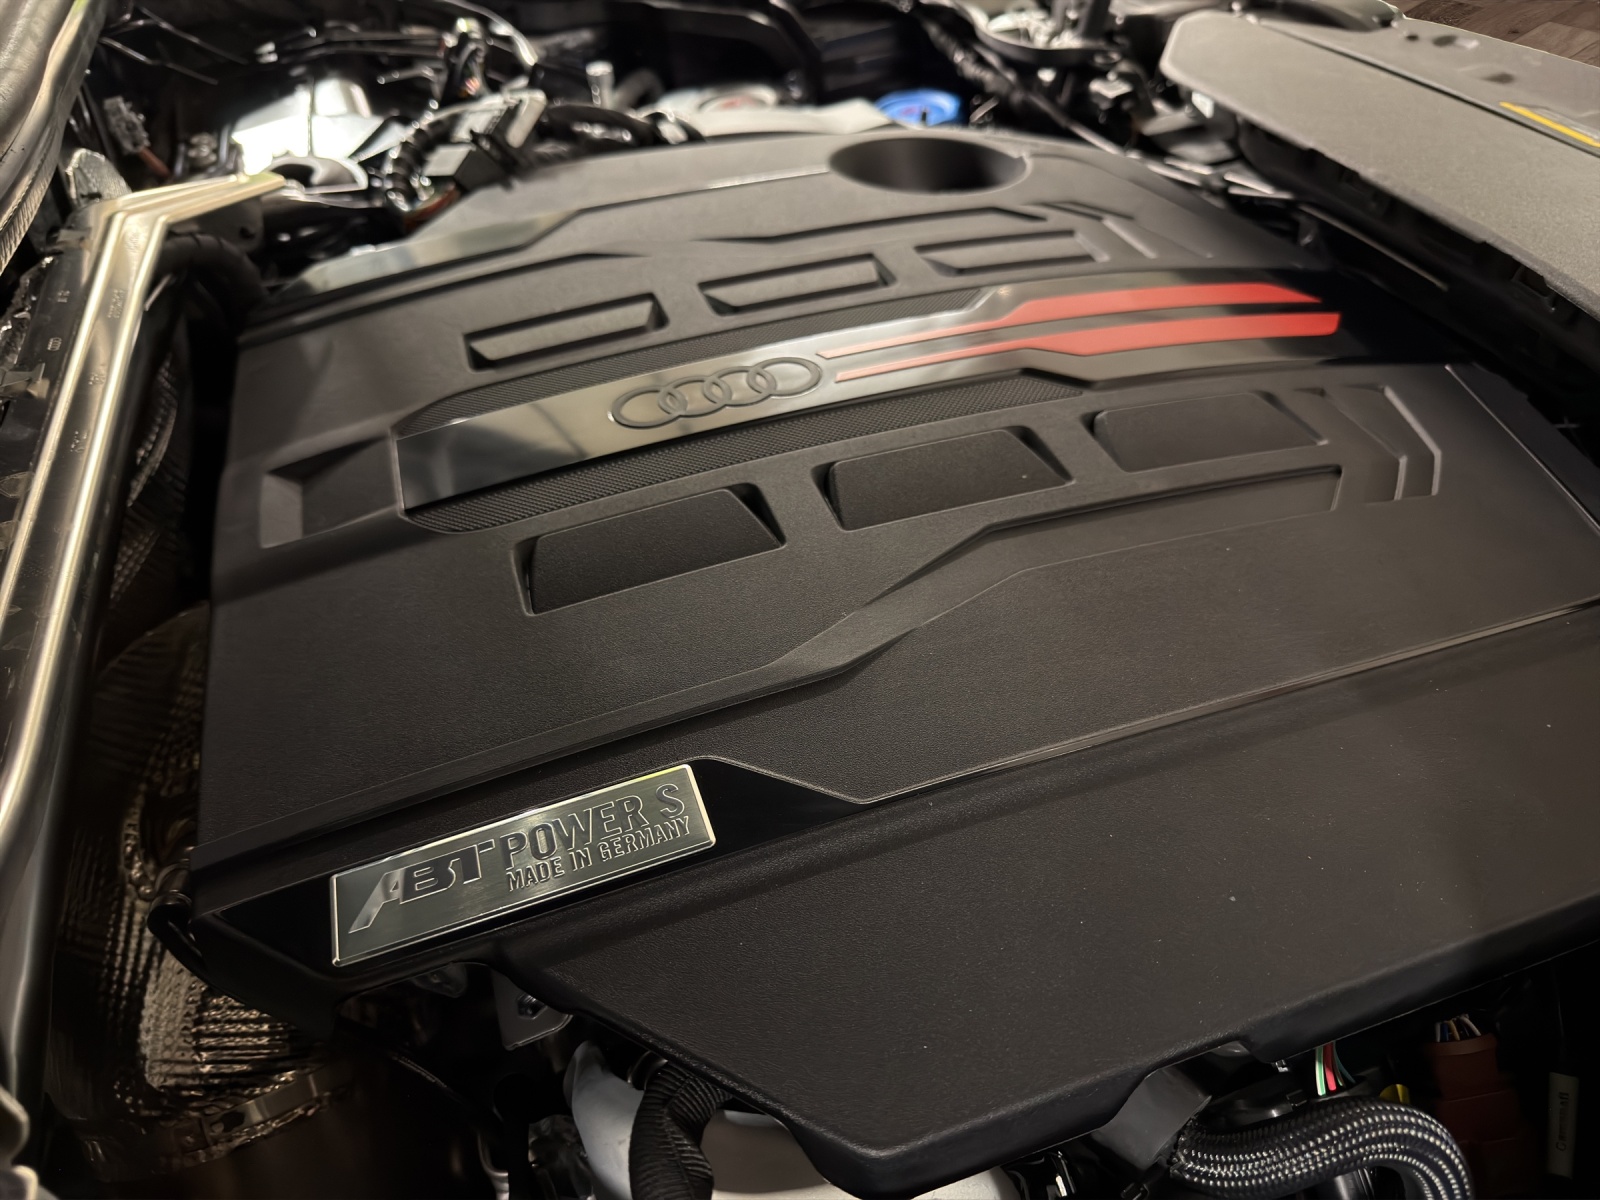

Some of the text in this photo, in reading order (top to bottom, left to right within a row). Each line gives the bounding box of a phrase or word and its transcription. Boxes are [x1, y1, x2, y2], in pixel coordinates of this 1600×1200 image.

[348, 783, 686, 934] ABT POWER S
[506, 815, 692, 892] MADE IN GERMANY
